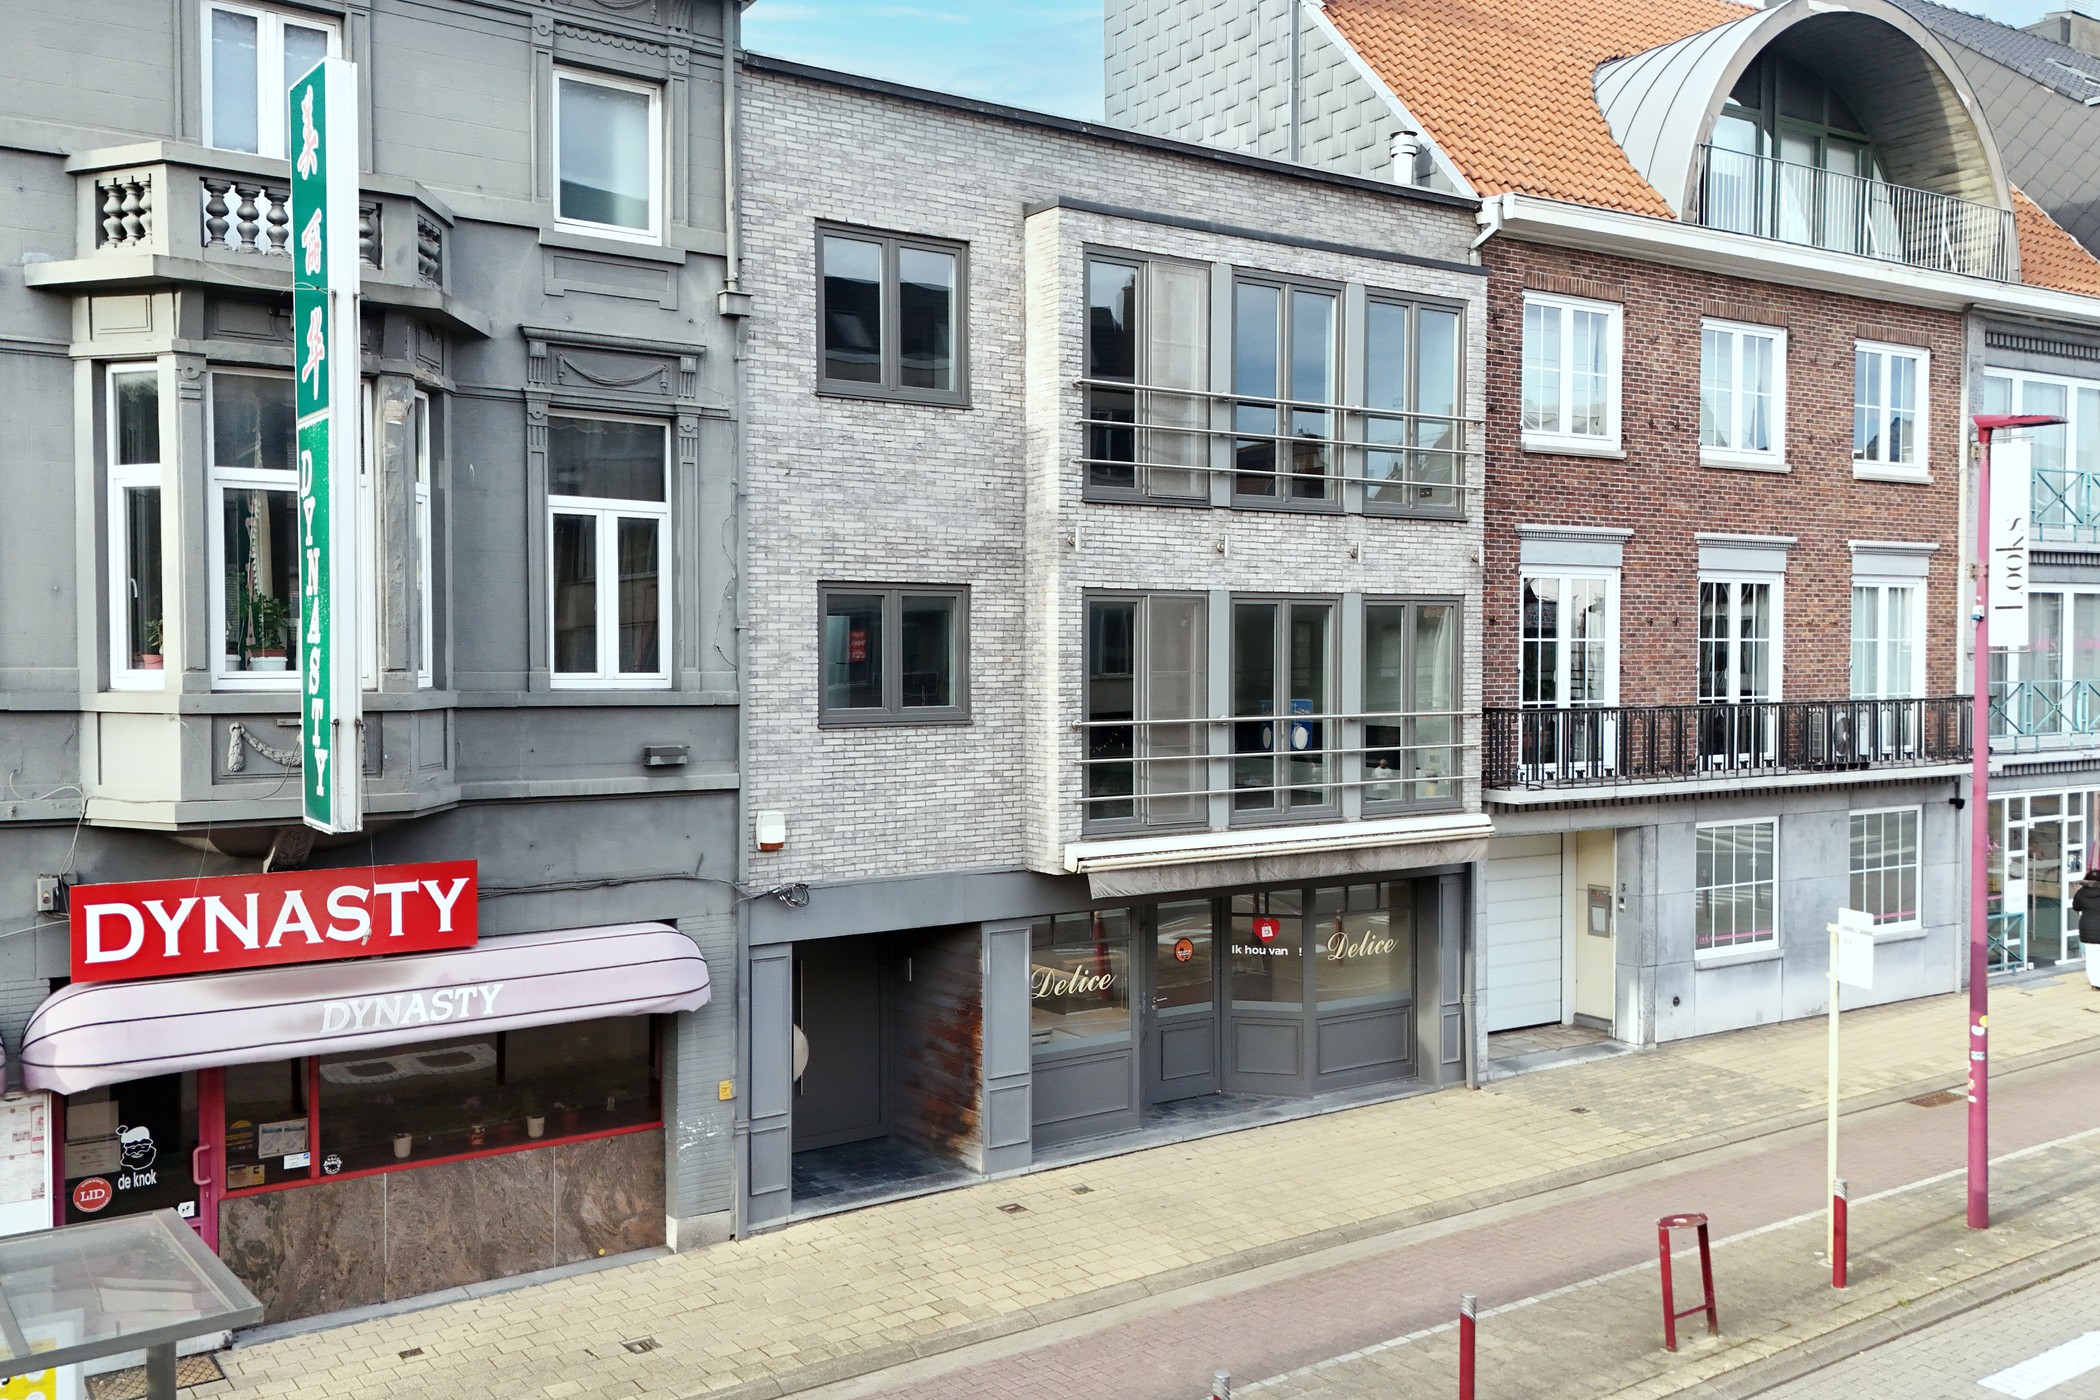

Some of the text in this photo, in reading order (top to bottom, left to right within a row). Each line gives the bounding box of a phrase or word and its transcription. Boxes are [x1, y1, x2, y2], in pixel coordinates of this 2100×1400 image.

[1994, 517, 2024, 610] Looks
[300, 449, 328, 797] DYNASTY
[1621, 883, 1626, 892] 3
[83, 877, 470, 964] DYNASTY
[1231, 945, 1242, 954] Ik
[1244, 945, 1266, 955] hou
[1268, 948, 1289, 956] van
[1327, 930, 1398, 960] Delice
[1031, 965, 1117, 999] Delice
[320, 984, 503, 1034] DYNASTY
[80, 1189, 106, 1202] LID
[118, 1174, 131, 1190] de
[133, 1169, 157, 1187] knok
